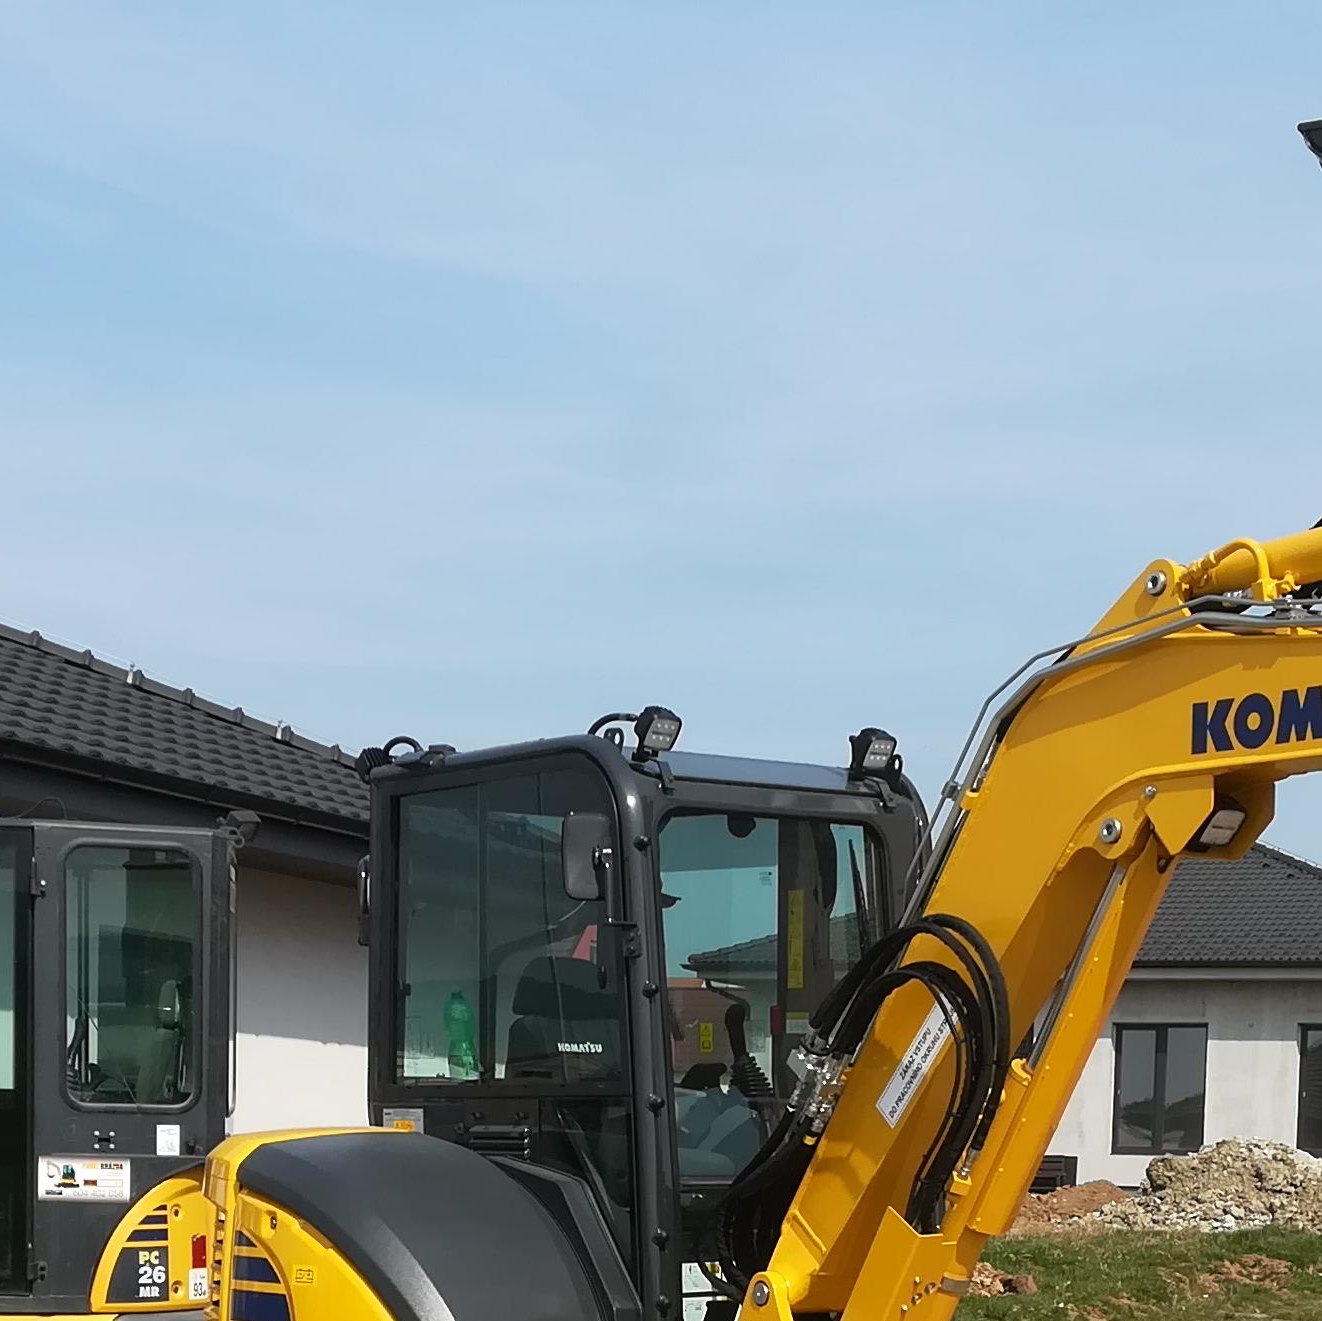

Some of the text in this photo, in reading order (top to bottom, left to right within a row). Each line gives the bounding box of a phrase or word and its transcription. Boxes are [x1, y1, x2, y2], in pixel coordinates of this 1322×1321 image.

[557, 1041, 603, 1053] KOMATSU
[912, 1027, 932, 1057] VSTUPU
[138, 1250, 160, 1265] PC
[138, 1265, 166, 1284] 26
[139, 1285, 160, 1298] MR
